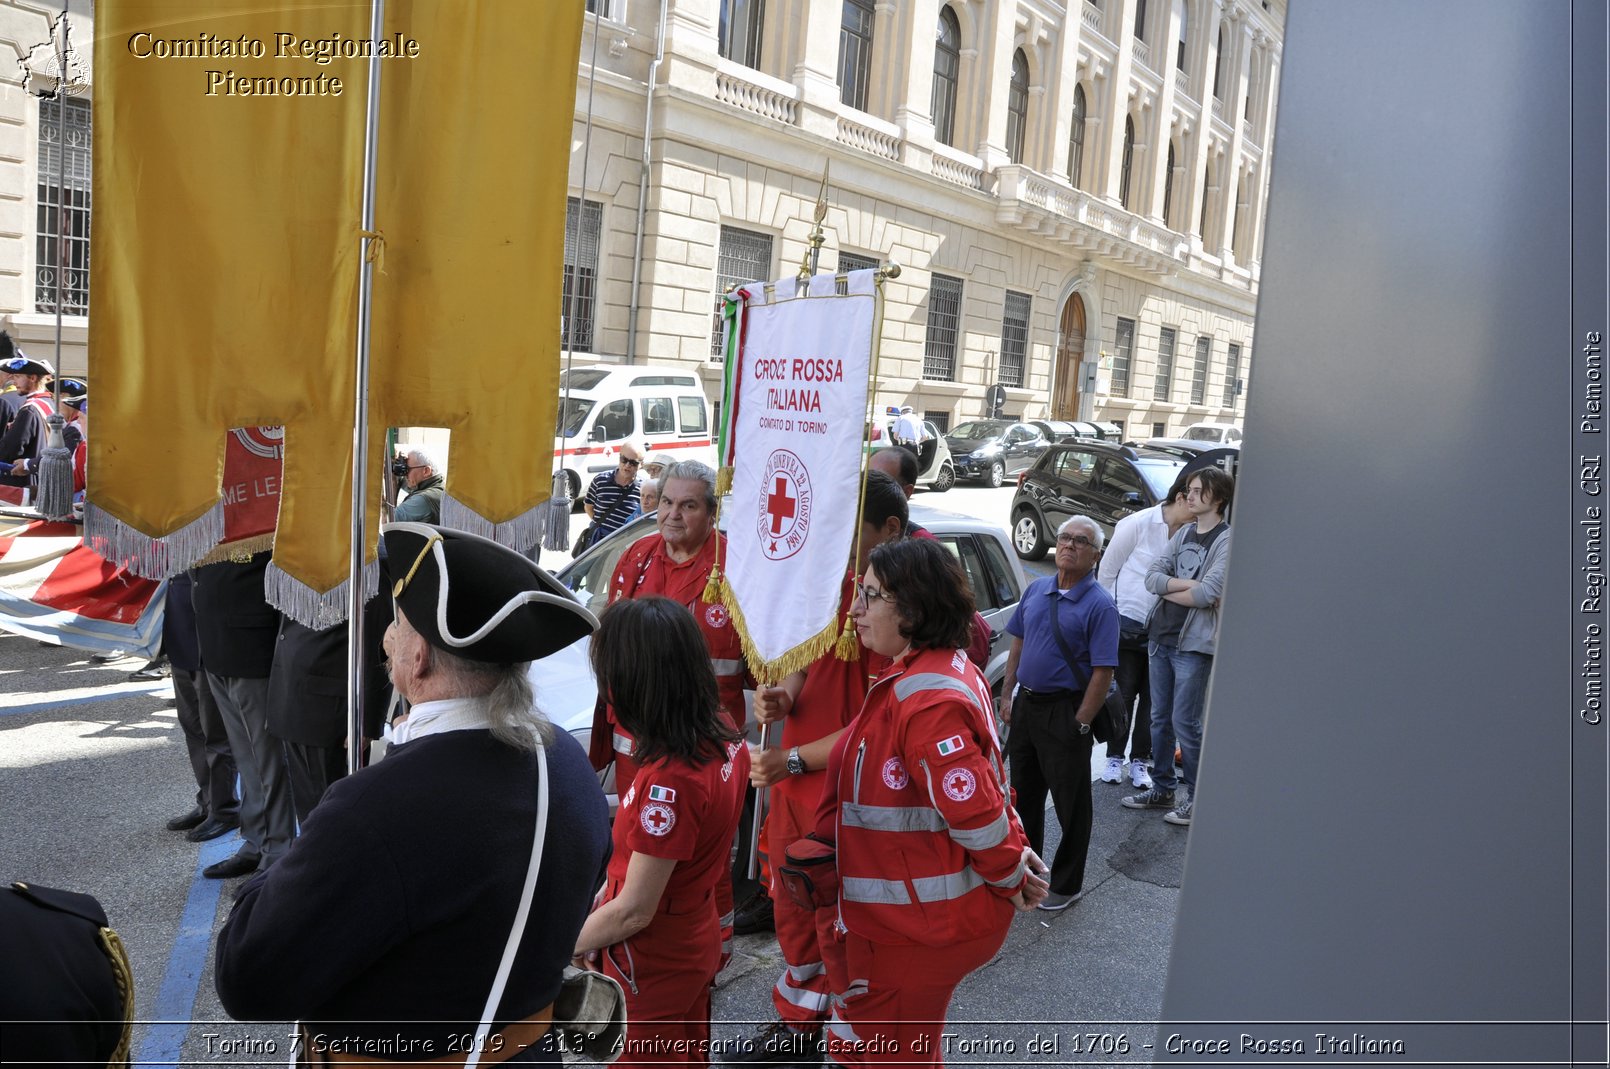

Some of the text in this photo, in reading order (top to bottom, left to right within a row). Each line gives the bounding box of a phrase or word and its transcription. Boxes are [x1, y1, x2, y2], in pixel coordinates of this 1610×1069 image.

[754, 358, 843, 383] CROCE ROSSA
[766, 388, 822, 413] ITALIANA
[785, 419, 794, 432] DI
[797, 421, 828, 435] TORINO
[254, 476, 279, 498] LE
[796, 472, 807, 488] 22
[798, 489, 810, 533] AGOSTO
[786, 530, 802, 551] 1864
